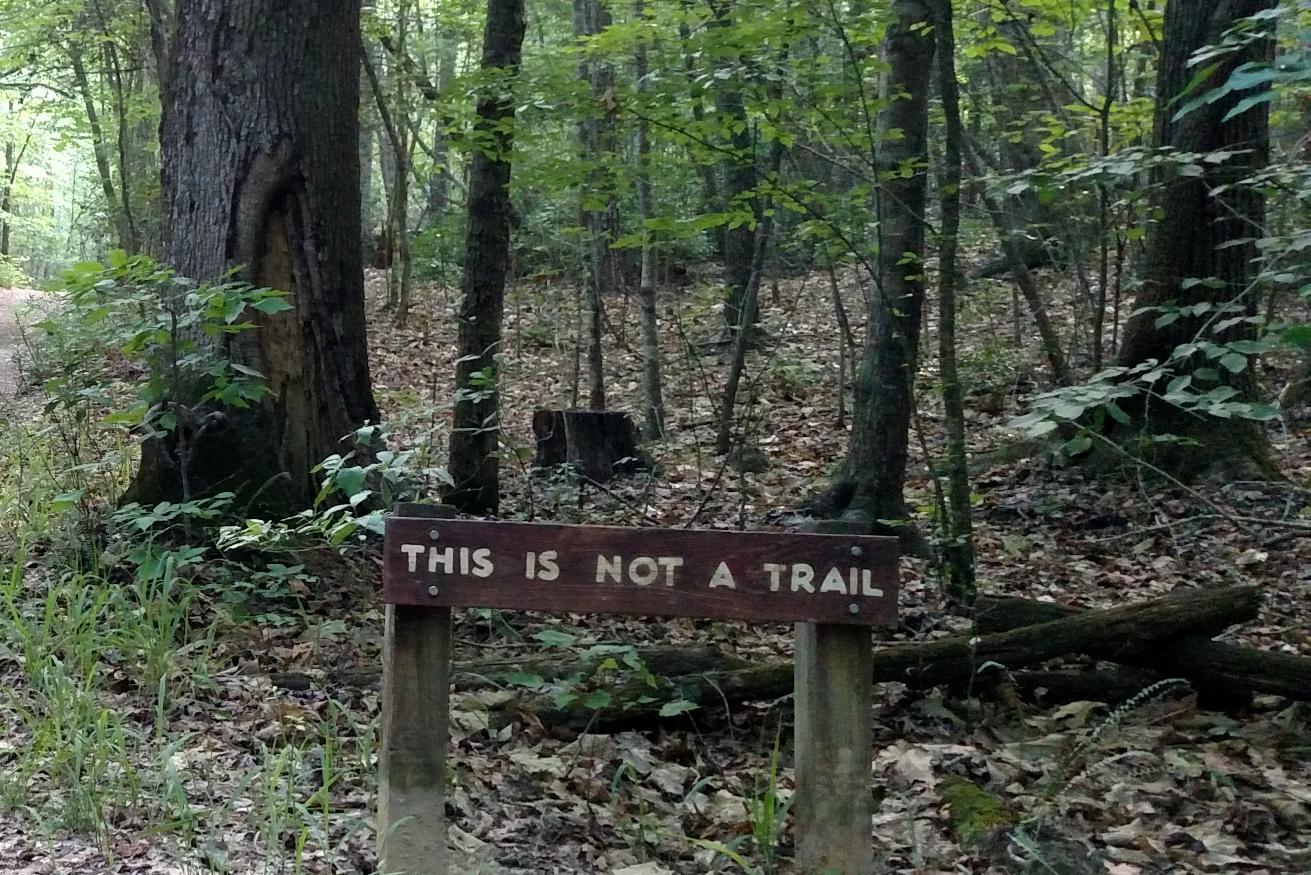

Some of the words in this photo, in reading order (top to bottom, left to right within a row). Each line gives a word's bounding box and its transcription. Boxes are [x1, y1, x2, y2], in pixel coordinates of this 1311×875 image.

[401, 544, 494, 578] THIS
[525, 550, 560, 580] IS
[596, 555, 684, 586] NOT
[709, 561, 736, 589] A
[763, 563, 884, 597] TRAIL
